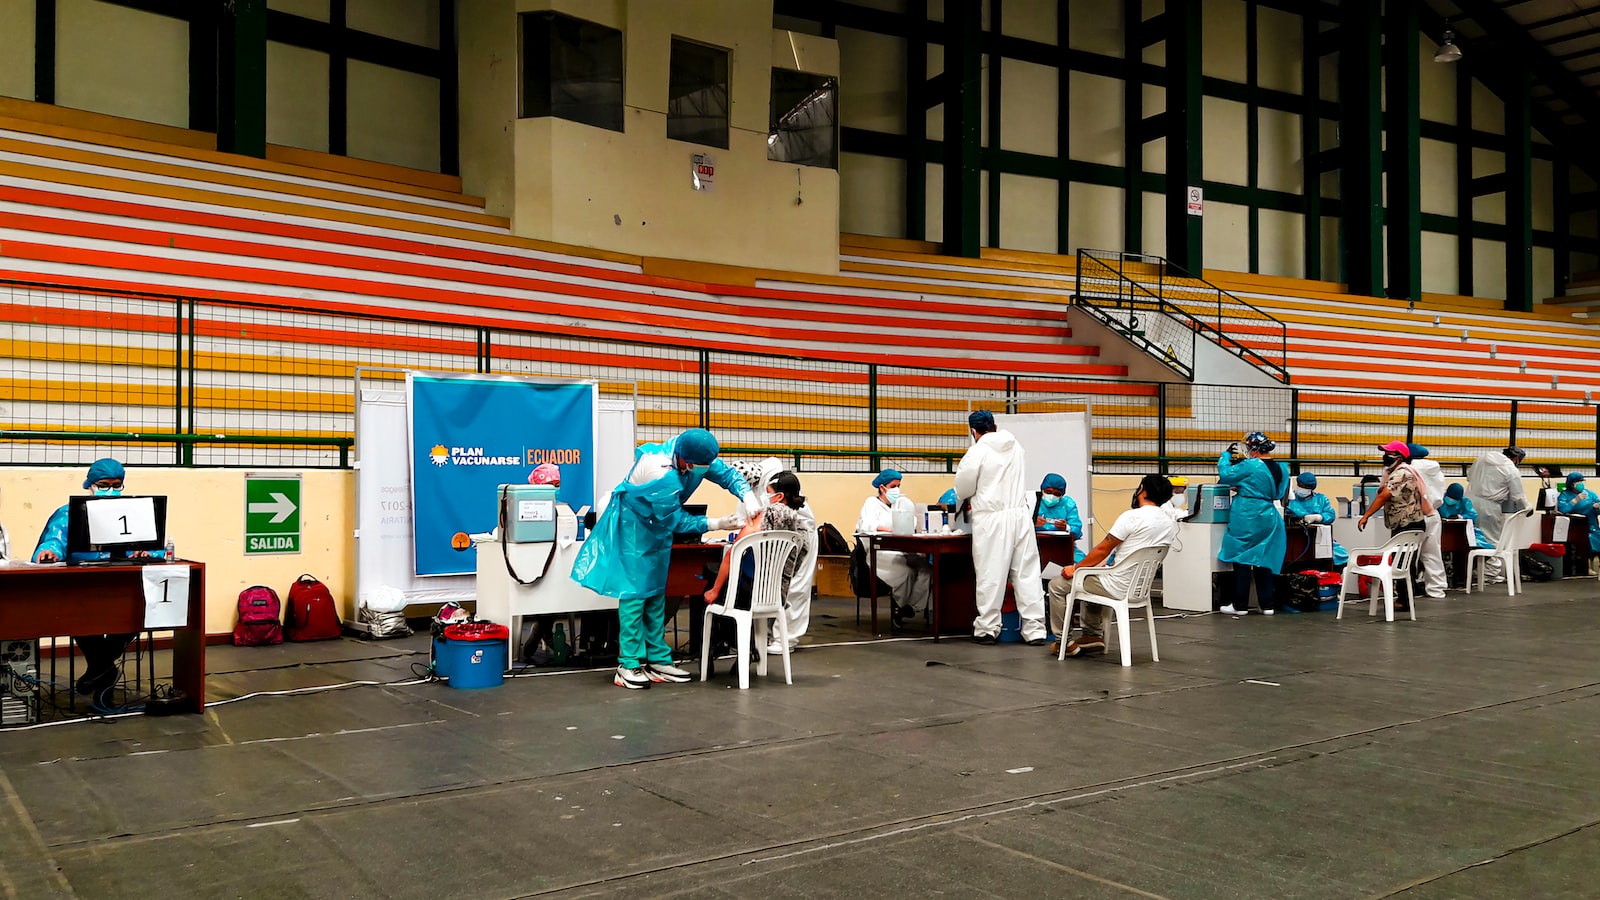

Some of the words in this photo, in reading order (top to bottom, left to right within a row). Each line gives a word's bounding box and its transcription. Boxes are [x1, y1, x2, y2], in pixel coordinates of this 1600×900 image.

[452, 448, 483, 456] PLAN
[452, 457, 520, 465] VACUNARSE
[527, 449, 581, 464] ECUADOR
[118, 515, 132, 535] 1
[250, 537, 294, 550] SALIDA
[159, 579, 172, 603] 1
